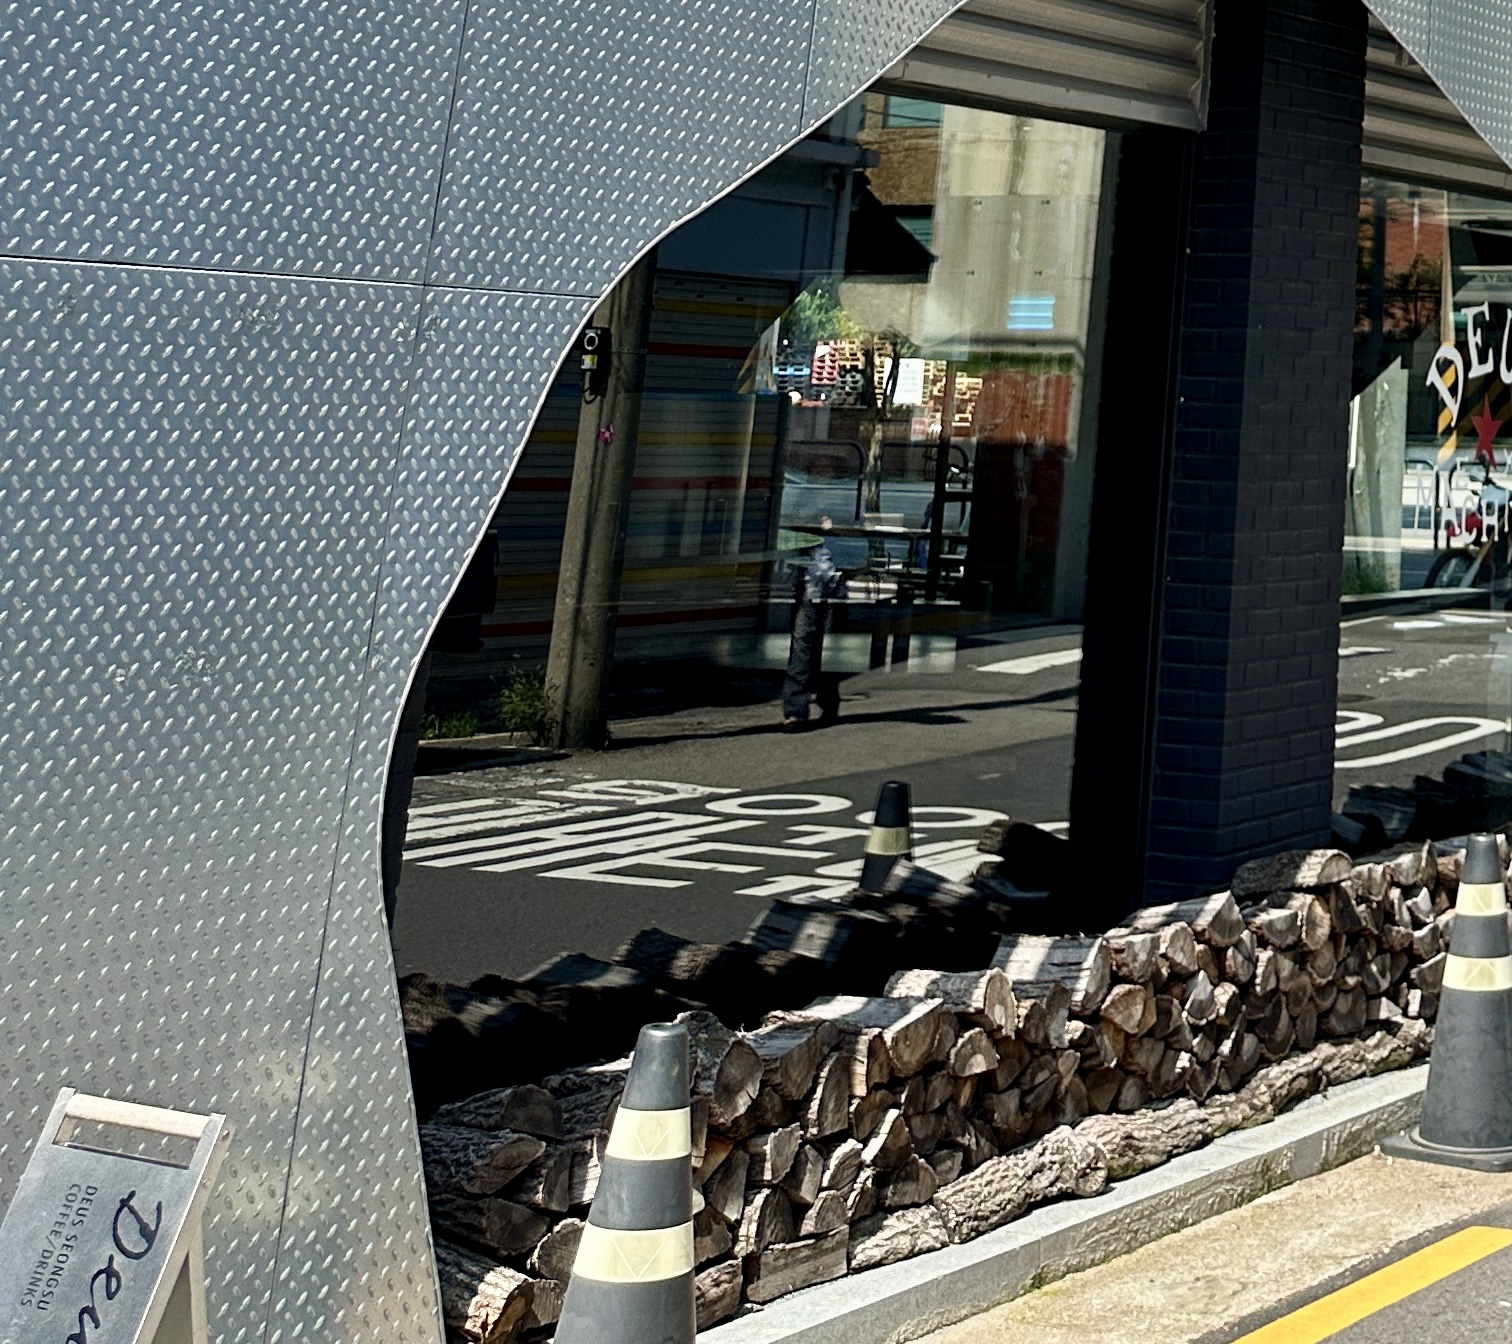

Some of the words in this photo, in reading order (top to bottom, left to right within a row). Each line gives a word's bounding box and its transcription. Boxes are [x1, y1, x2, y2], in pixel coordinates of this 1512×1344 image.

[21, 1183, 81, 1307] COFFEE/DRINKS
[71, 1185, 98, 1228] DEUS
[37, 1233, 78, 1311] SEONGSU
